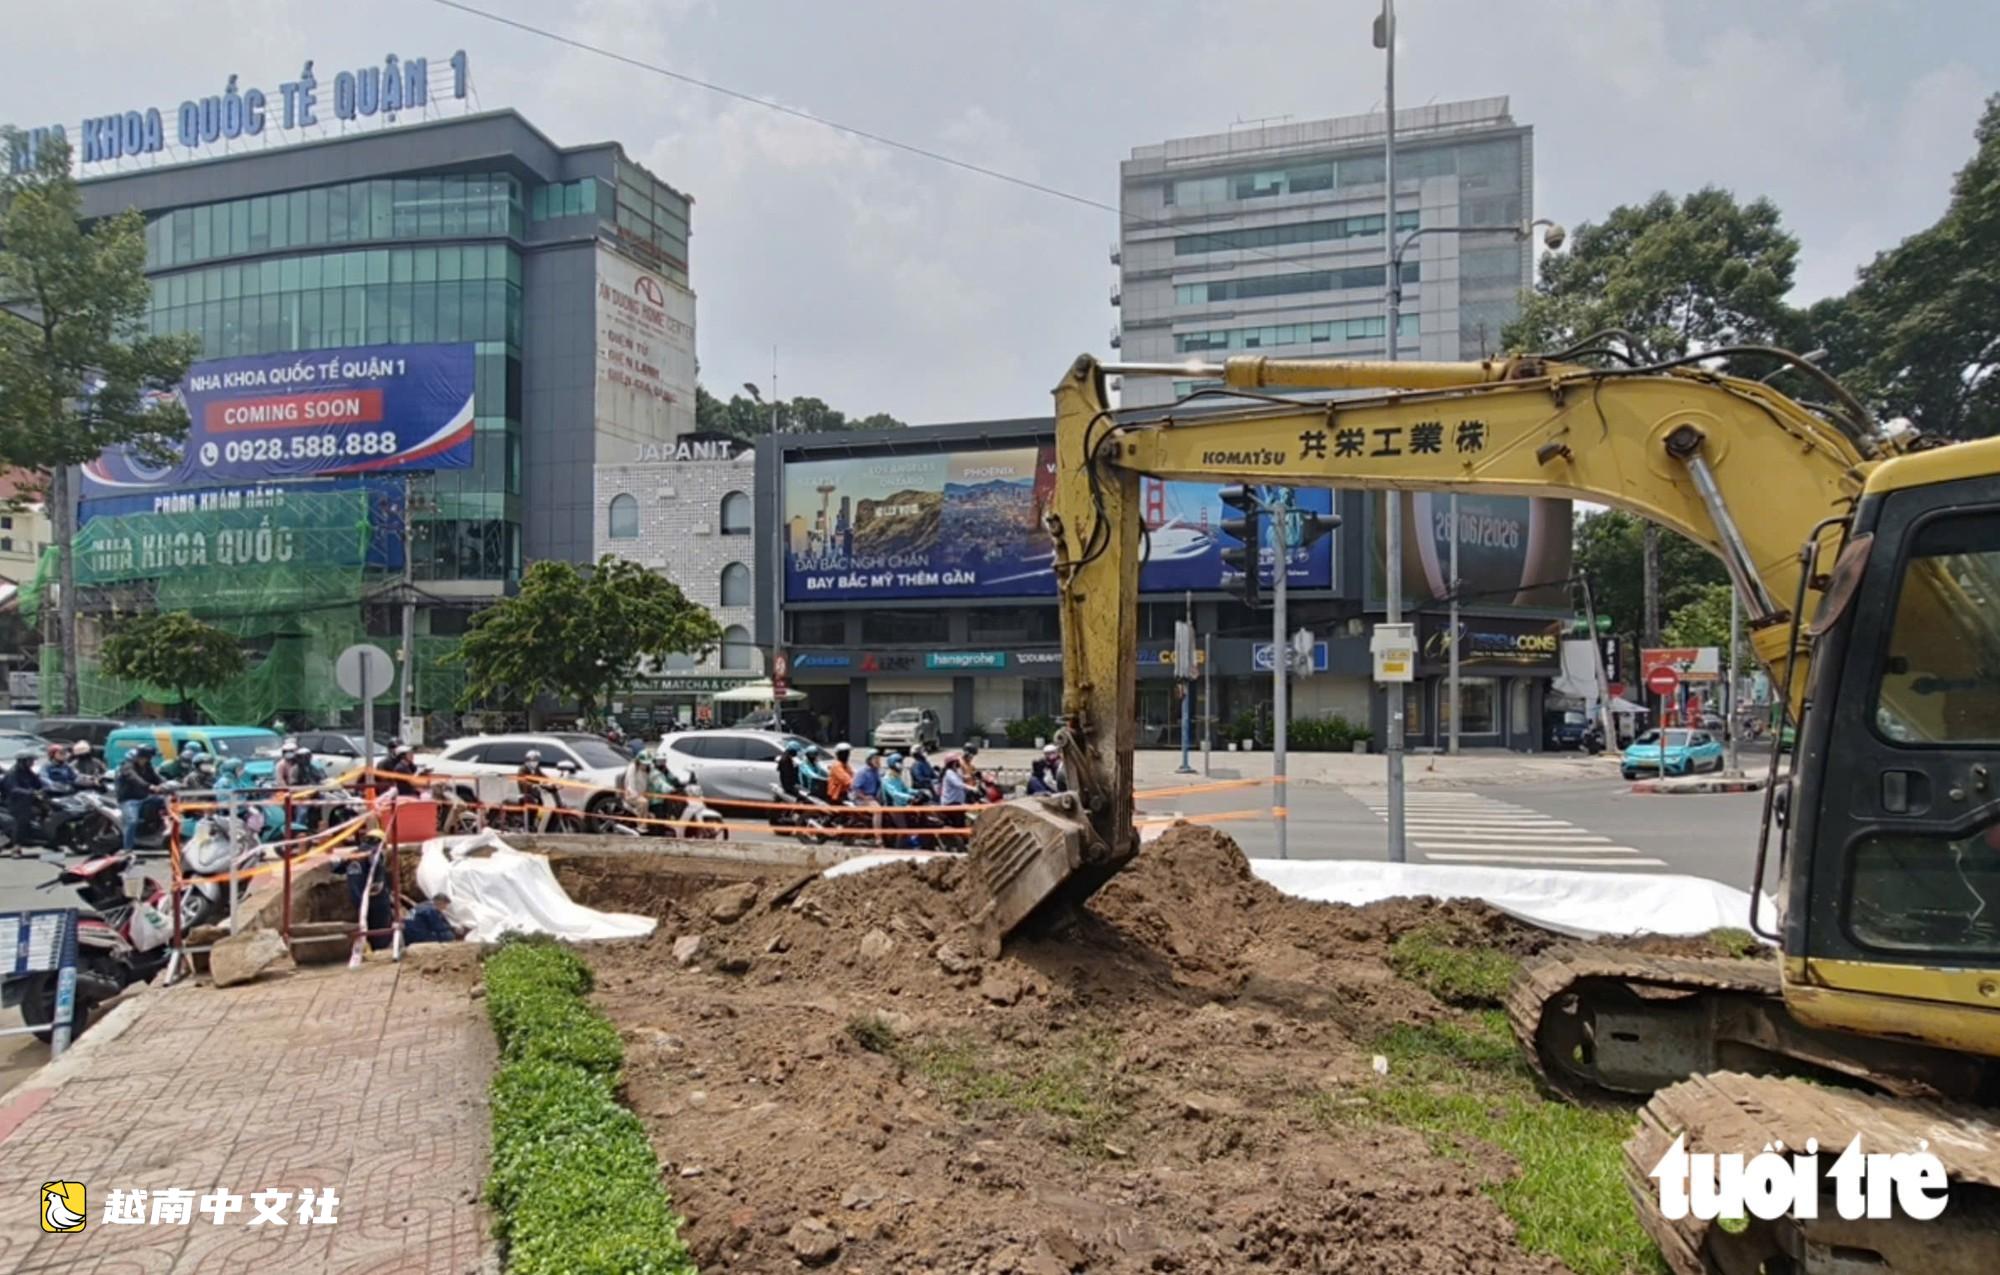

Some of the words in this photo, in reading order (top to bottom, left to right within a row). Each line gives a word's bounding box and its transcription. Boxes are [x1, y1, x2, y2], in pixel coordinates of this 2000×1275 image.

[81, 107, 164, 163] KHOA
[178, 74, 265, 148] QUỐC
[279, 60, 317, 130] TẾ
[334, 53, 427, 122] QUẬN
[451, 49, 467, 99] 1
[190, 374, 221, 392] NHA
[224, 370, 267, 388] KHOA
[269, 360, 315, 383] QUỐC
[319, 356, 339, 379] TẾ
[342, 357, 393, 380] QUẬN
[397, 359, 405, 375] 1
[224, 403, 297, 424] COMING
[304, 398, 360, 419] SOON
[225, 431, 397, 462] 0928.588.888
[634, 440, 733, 463] JAPANIT
[1203, 448, 1285, 465] KOMATSU
[964, 466, 1015, 477] PHOENIX
[92, 538, 133, 572] NHA
[142, 531, 208, 569] KHOA
[216, 515, 293, 565] QUỐC
[807, 576, 835, 589] BAY
[933, 652, 995, 667] hansgrohe
[662, 679, 709, 690] MATCHA
